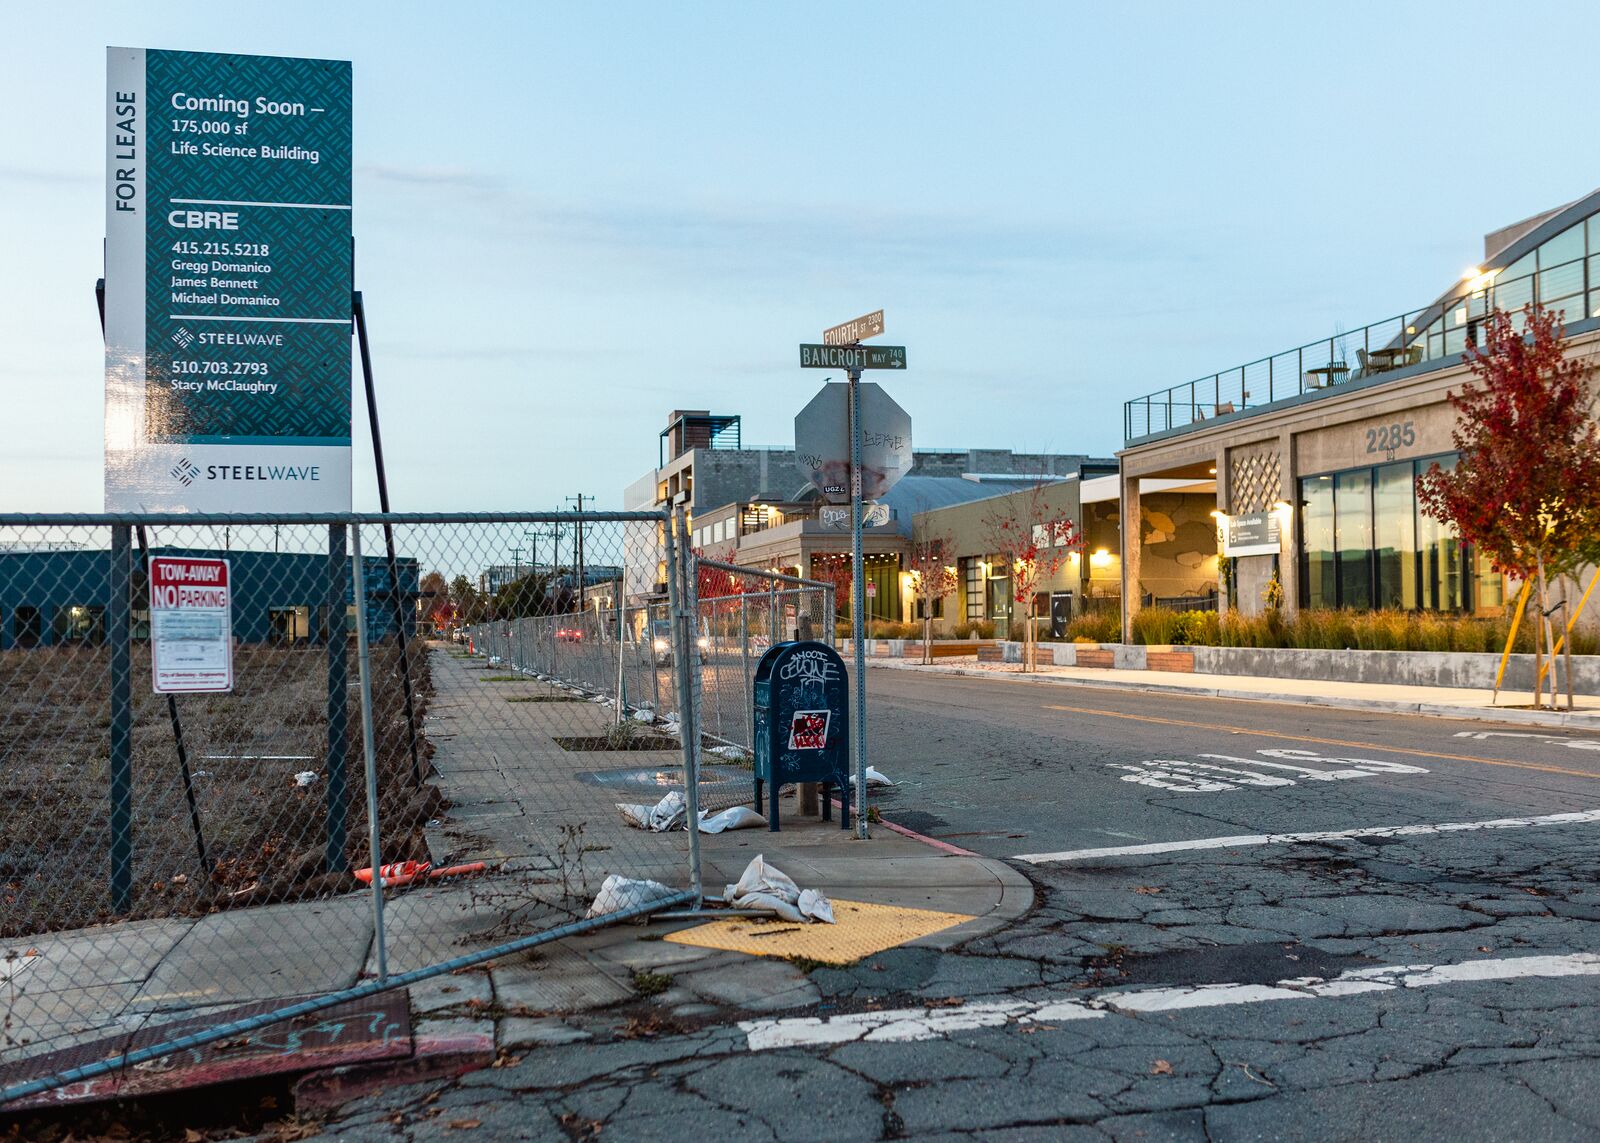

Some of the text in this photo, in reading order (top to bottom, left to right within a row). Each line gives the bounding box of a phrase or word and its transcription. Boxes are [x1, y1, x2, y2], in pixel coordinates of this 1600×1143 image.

[171, 92, 249, 118] Coming
[255, 97, 305, 116] Soon
[171, 119, 248, 135] 175,000 sf
[116, 91, 136, 212] FOR LEASE
[171, 141, 320, 164] Life Science Building
[168, 210, 239, 230] CBRE
[171, 242, 269, 257] 415.215.5218
[171, 259, 271, 274] Gregg Domanico
[171, 276, 258, 289] James Bennett
[171, 292, 280, 306] Michael Domanico
[199, 332, 283, 346] STEELWAVE
[824, 322, 859, 345] FOURTH
[860, 323, 867, 334] ST
[803, 348, 903, 366] BANCROFT WAY 740
[171, 361, 269, 375] 510.703.2793
[171, 380, 277, 394] Stacy McClaughry
[1366, 421, 1415, 453] 2285
[207, 466, 320, 481] STEELWAVE
[158, 564, 221, 582] TOW-AWAY
[153, 585, 225, 608] NO PARKING
[1106, 749, 1430, 792] STOP
